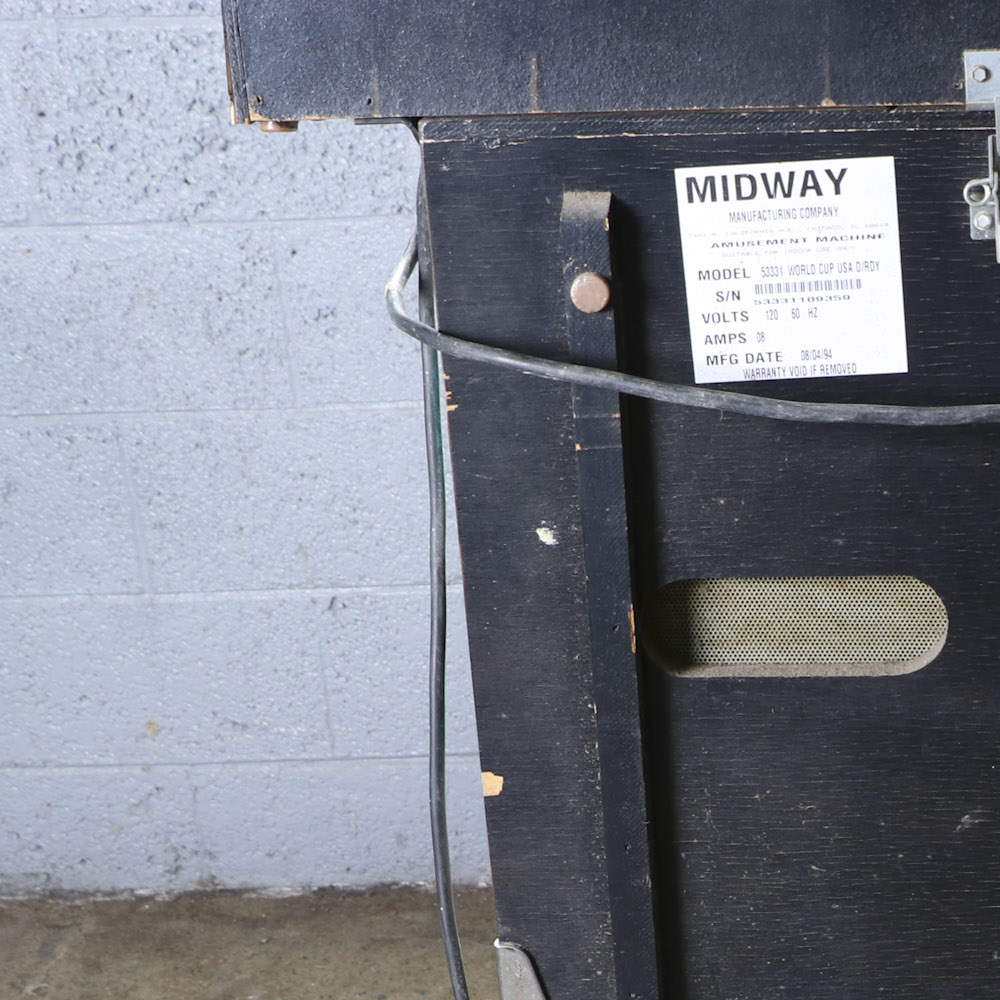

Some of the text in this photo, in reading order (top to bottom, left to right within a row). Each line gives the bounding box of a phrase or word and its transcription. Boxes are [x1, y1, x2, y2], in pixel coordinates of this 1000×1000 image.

[685, 167, 848, 204] MIDWAY
[729, 205, 839, 223] MANUFACTURING COMPANY
[711, 233, 887, 249] AMUSEMENT MACHINE
[698, 260, 880, 281] MODEL 53331 WORLD CUP USA D/RDY
[716, 290, 741, 302] S/N
[702, 306, 819, 324] VOLTS 120 60 HZ
[704, 332, 747, 346] AMPS
[706, 348, 833, 366] MFG DATE 08/04/94
[743, 362, 857, 380] WARRANTY VOID IF REMOVED
